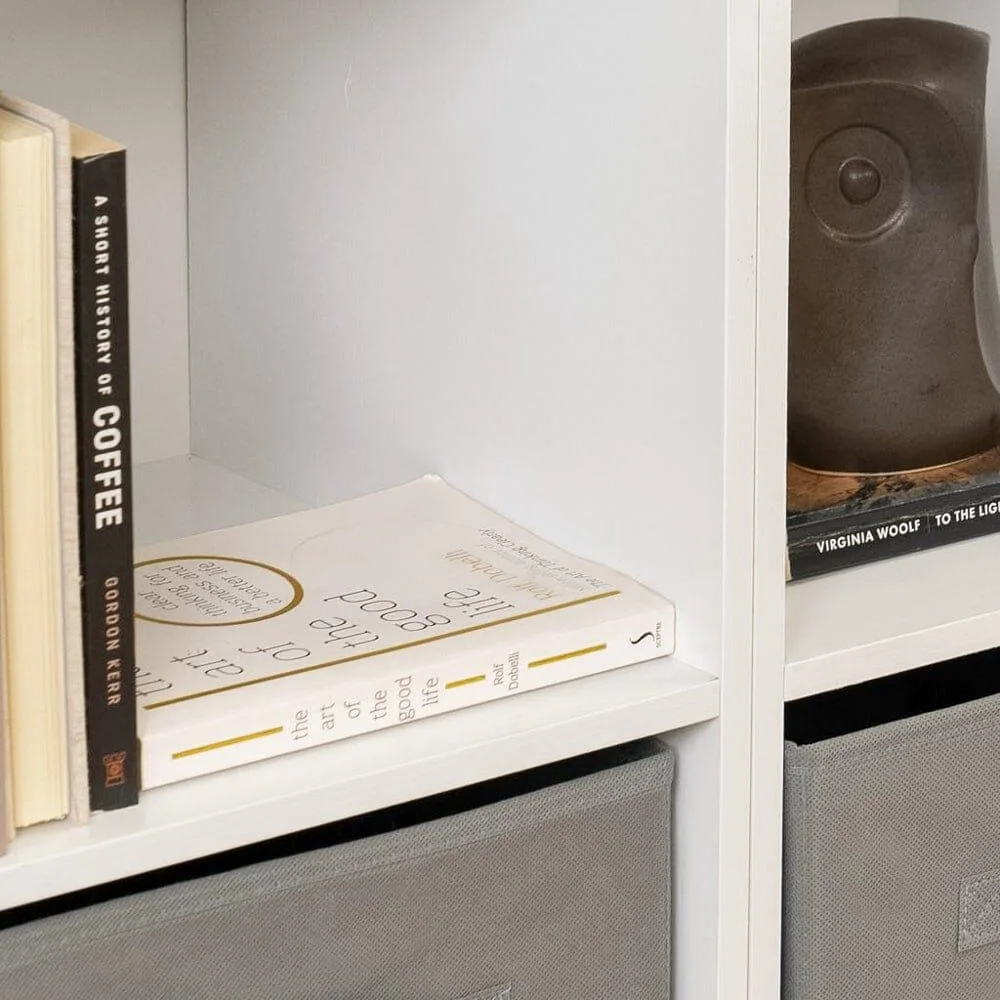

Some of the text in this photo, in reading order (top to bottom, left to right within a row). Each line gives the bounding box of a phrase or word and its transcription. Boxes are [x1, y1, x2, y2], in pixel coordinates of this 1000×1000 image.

[92, 195, 123, 531] A SHORT HISTORY OF COFFEE
[816, 530, 874, 554] VIRGINIA
[876, 519, 921, 540] WOOLF
[935, 513, 951, 527] TO
[954, 507, 976, 522] THE
[138, 591, 178, 610] clear
[144, 573, 228, 617] thinking for
[161, 564, 260, 615] business and
[222, 574, 269, 600] better
[443, 588, 515, 617] life
[323, 589, 451, 631] good
[104, 576, 122, 707] GORDON KERR
[309, 616, 379, 648] the
[169, 649, 243, 678] art
[238, 641, 311, 661] of
[492, 663, 504, 686] Rolf
[507, 650, 519, 690] Dobelli
[370, 689, 388, 720] the
[394, 675, 416, 722] good
[422, 676, 440, 708] life
[291, 709, 308, 740] the
[320, 700, 335, 730] art
[344, 700, 361, 719] of
